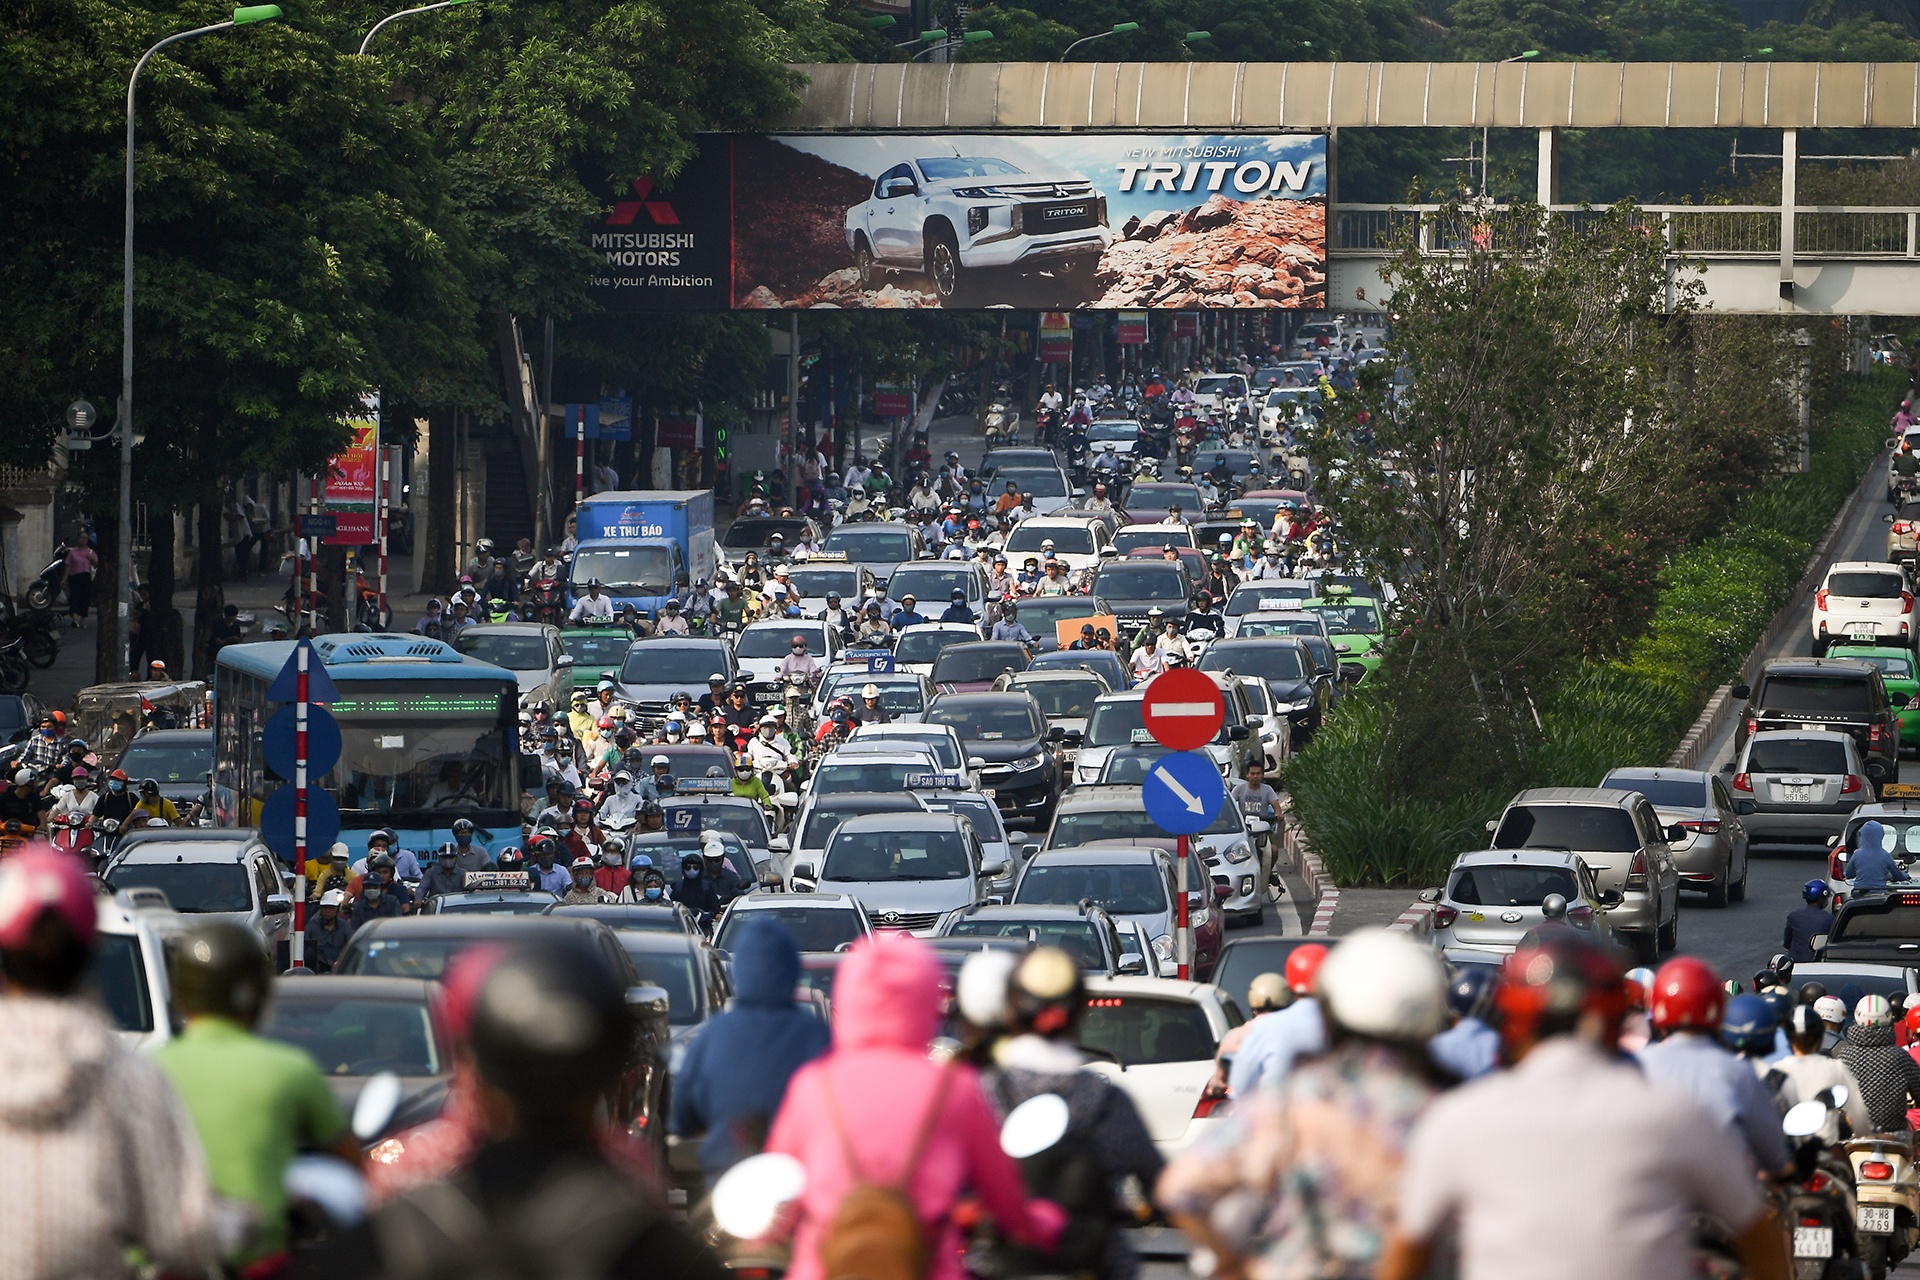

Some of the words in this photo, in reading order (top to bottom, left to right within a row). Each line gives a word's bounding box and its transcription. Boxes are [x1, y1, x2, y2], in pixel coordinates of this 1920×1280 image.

[1121, 149, 1155, 158] NEW
[1159, 145, 1243, 158] MITSUBISHI
[1115, 160, 1312, 194] TRITON
[1047, 207, 1084, 217] TRITON
[591, 233, 694, 249] MITSUBISHI
[605, 251, 681, 267] MOTORS
[584, 274, 610, 287] ive
[613, 277, 645, 289] your
[648, 274, 714, 287] Ambition
[603, 525, 617, 537] XE
[618, 525, 640, 537] THƯ
[641, 523, 663, 536] BÁO
[874, 657, 888, 671] G7
[921, 777, 933, 786] SAO
[1790, 785, 1804, 793] 30E
[1784, 793, 1809, 801] 85196
[675, 810, 693, 828] G7
[1863, 1208, 1890, 1220] 30-H8
[1863, 1219, 1890, 1231] 2769
